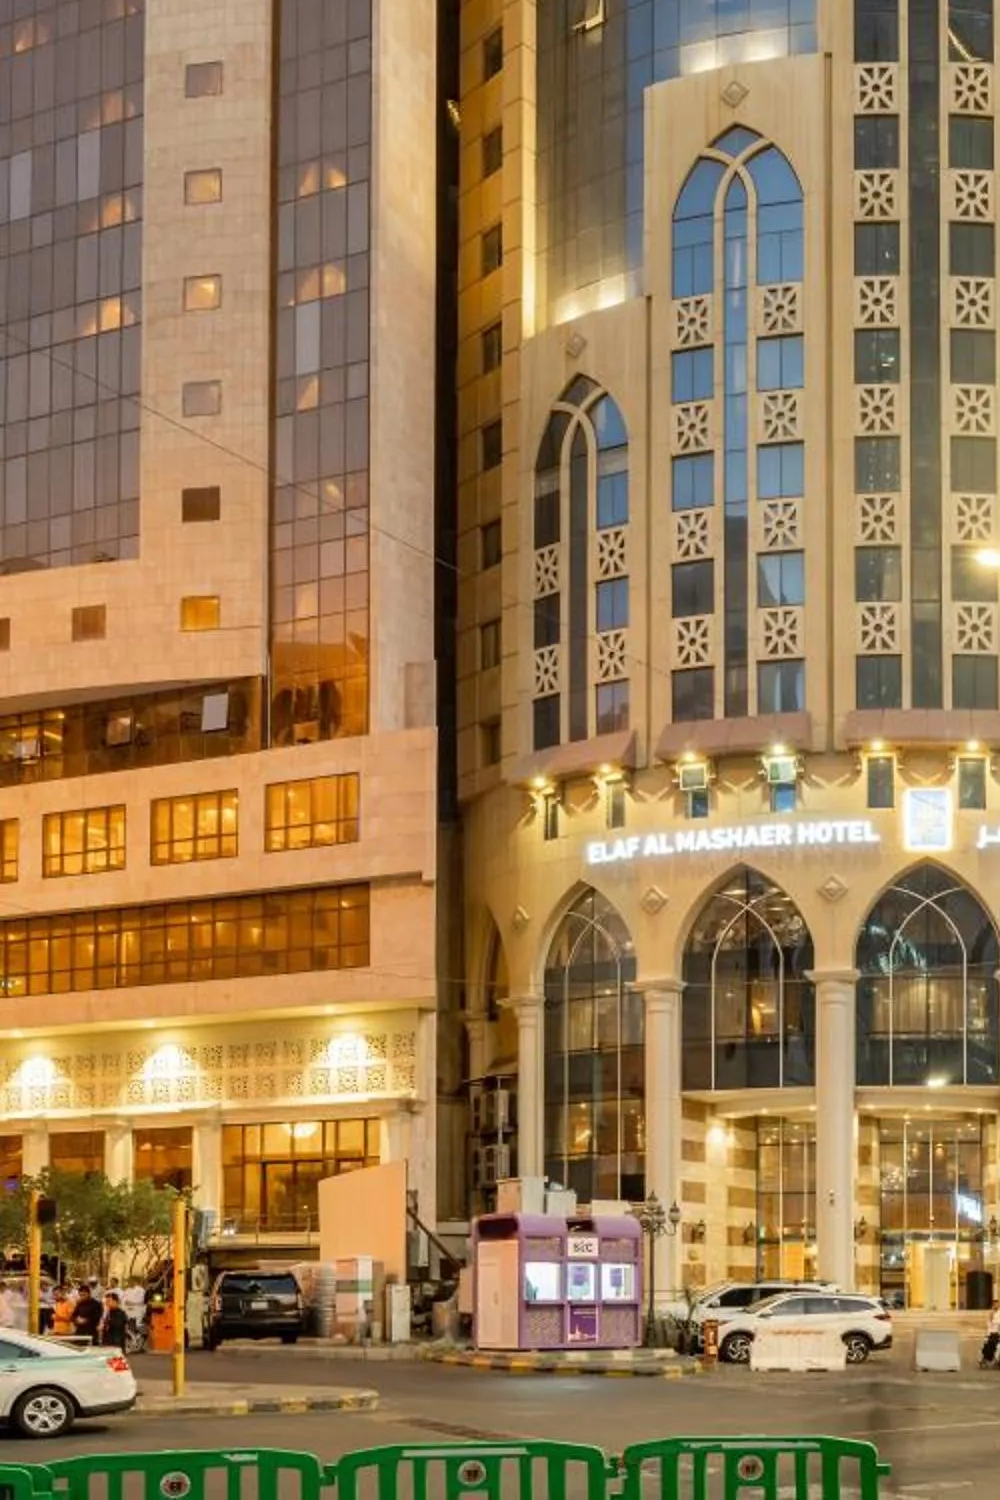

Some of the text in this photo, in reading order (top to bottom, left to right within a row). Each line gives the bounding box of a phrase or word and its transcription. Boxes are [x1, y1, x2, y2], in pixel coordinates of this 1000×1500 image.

[588, 819, 881, 864] ELAF AL MASHAER HOTEL
